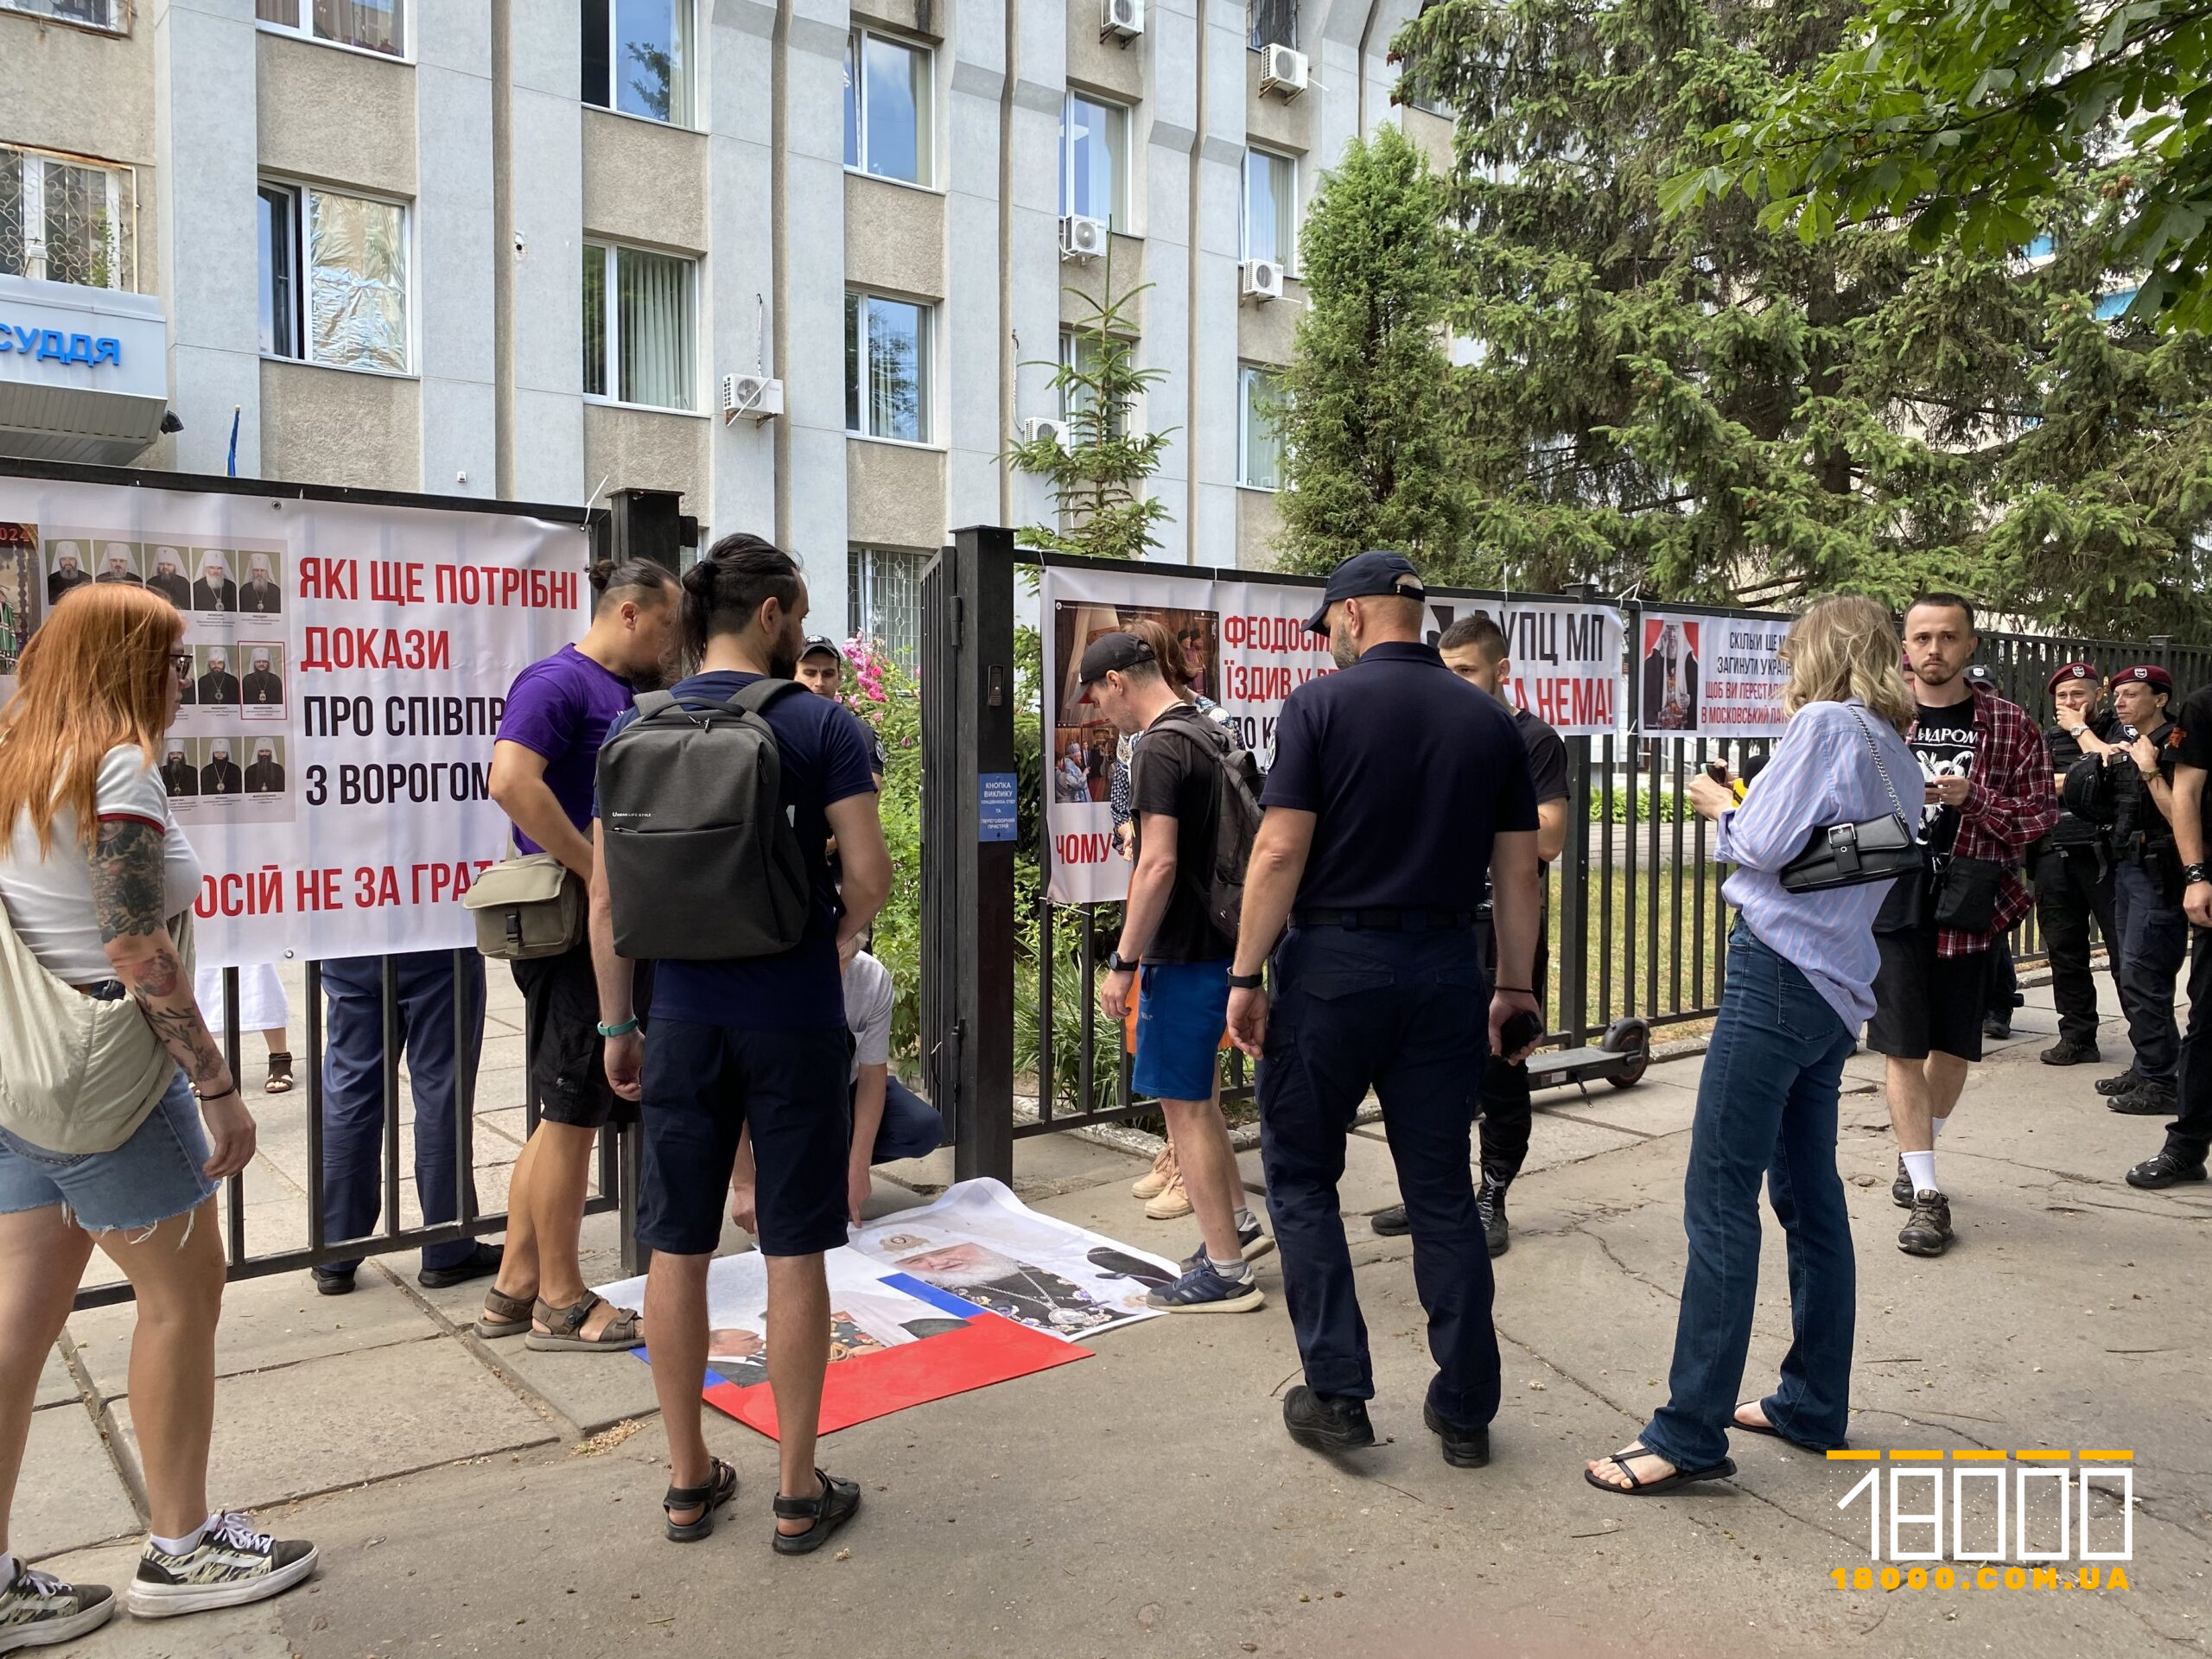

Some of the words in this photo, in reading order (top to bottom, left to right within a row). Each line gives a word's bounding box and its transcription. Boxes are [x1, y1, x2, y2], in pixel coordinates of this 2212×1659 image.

[299, 557, 359, 601] ЯКІ
[370, 560, 426, 607] ЩЕ
[435, 563, 578, 610] ПОТРІБНІ
[300, 626, 450, 672] ДОКАЗИ
[1499, 611, 1559, 666] УПЦ
[1567, 613, 1605, 662] МП
[1730, 632, 1763, 651] СКІЛЬКИ
[1765, 633, 1777, 652] ЩЕ
[1224, 659, 1292, 703] ЇЗДИВ
[1717, 657, 1758, 675] ЗАГИНУТИ
[1535, 677, 1614, 726] НЕМА!
[1705, 681, 1723, 700] ЩОБ
[1726, 682, 1738, 699] ВИ
[303, 696, 374, 737] ПРО
[1701, 707, 1707, 724] В
[1709, 704, 1770, 724] МОСКОВСЬКИЙ
[1914, 728, 1979, 744] НДРОМ
[306, 765, 327, 806] З
[1056, 833, 1112, 864] ЧОМУ
[296, 868, 343, 912] НЕ
[354, 865, 401, 908] ЗА
